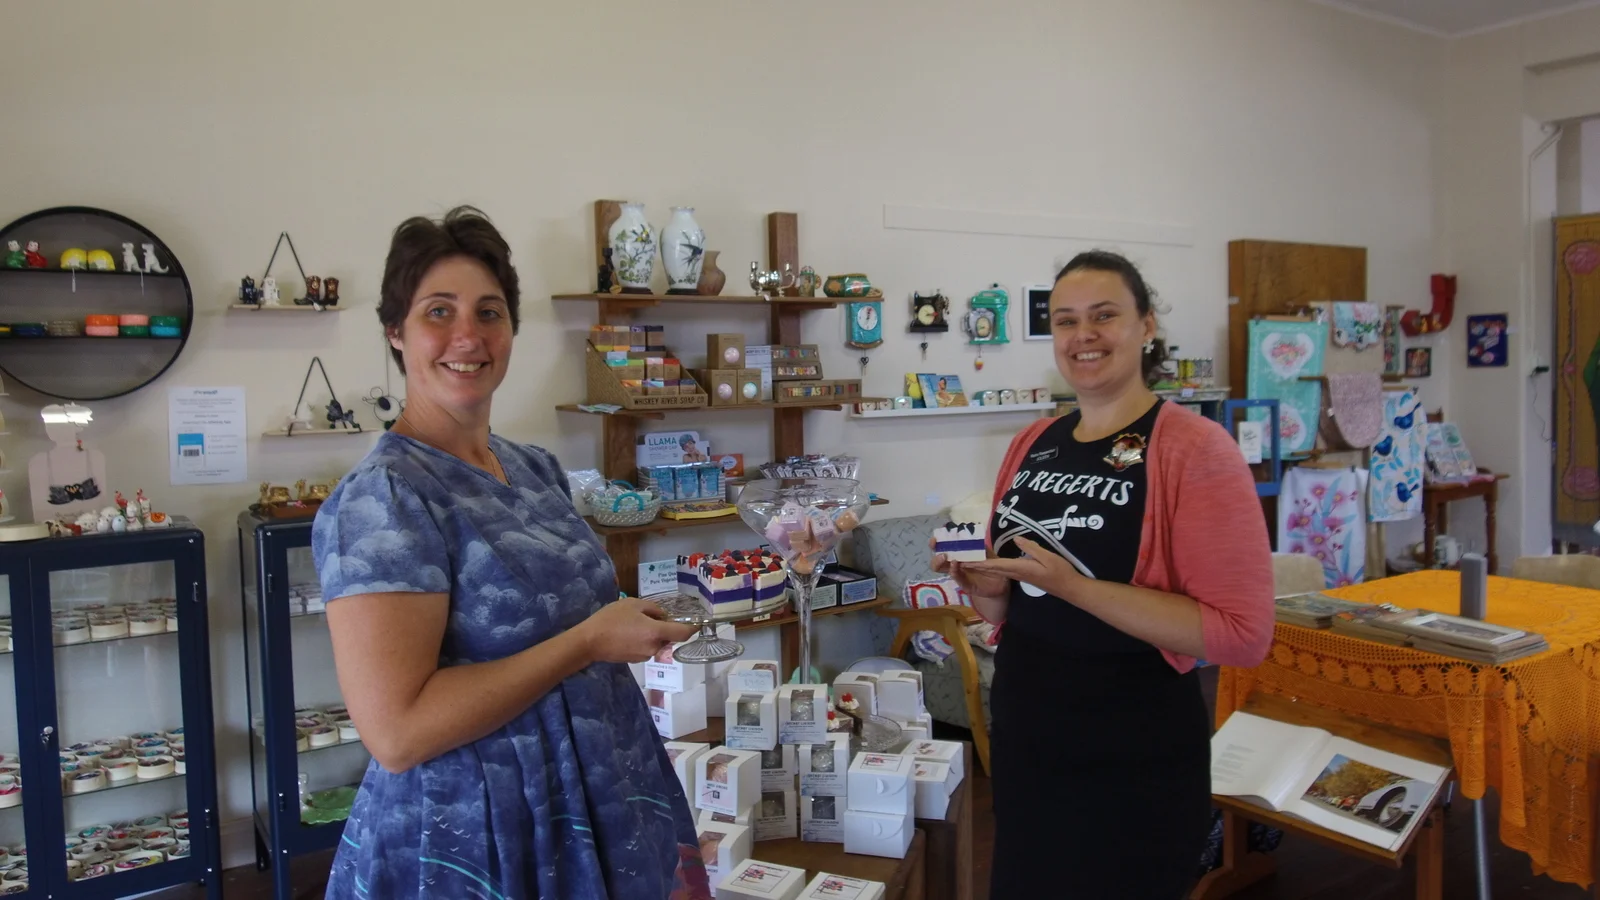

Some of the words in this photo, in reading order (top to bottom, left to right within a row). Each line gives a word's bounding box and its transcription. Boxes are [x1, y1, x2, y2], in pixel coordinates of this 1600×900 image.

[634, 397, 659, 406] WHISKEY
[660, 396, 678, 405] RIVER
[680, 396, 695, 405] SOAP
[648, 436, 677, 446] LLAMA
[1028, 470, 1134, 506] REGERTS
